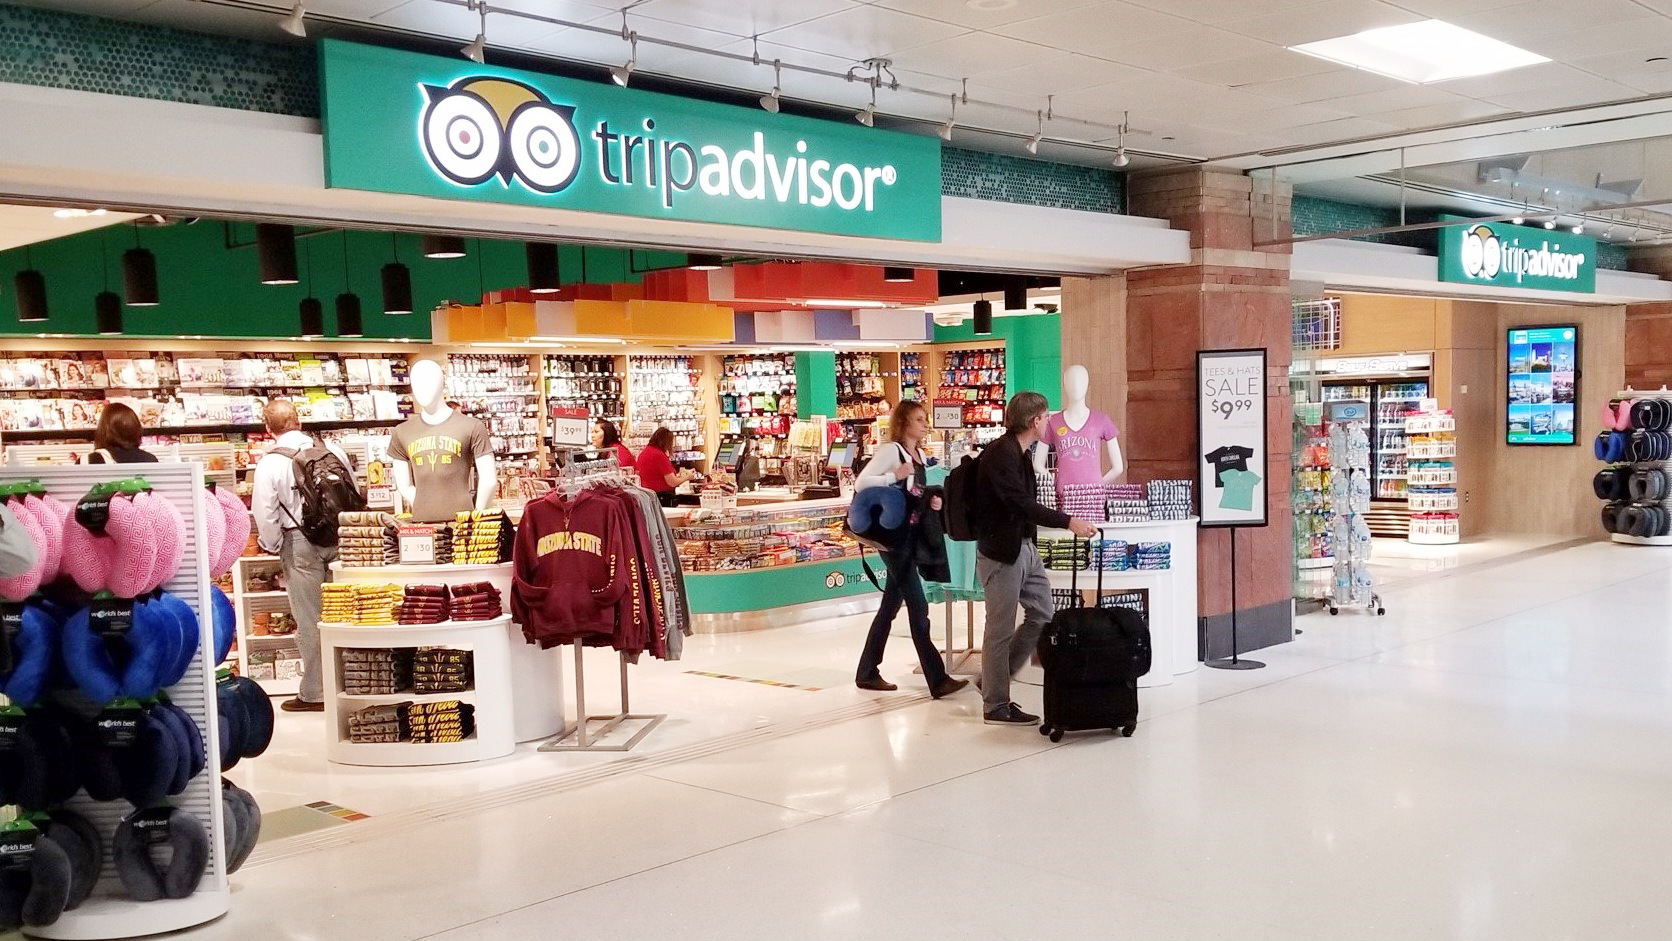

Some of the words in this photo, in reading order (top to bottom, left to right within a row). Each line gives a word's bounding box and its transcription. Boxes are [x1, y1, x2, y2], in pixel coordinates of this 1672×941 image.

[1204, 367, 1226, 376] TEES
[1227, 367, 1235, 376] &
[1236, 366, 1261, 375] HATS
[1204, 377, 1259, 397] SALE
[438, 435, 463, 458] STATE
[573, 531, 603, 557] STATE
[847, 568, 887, 584] tripaiso
[98, 719, 122, 728] world's
